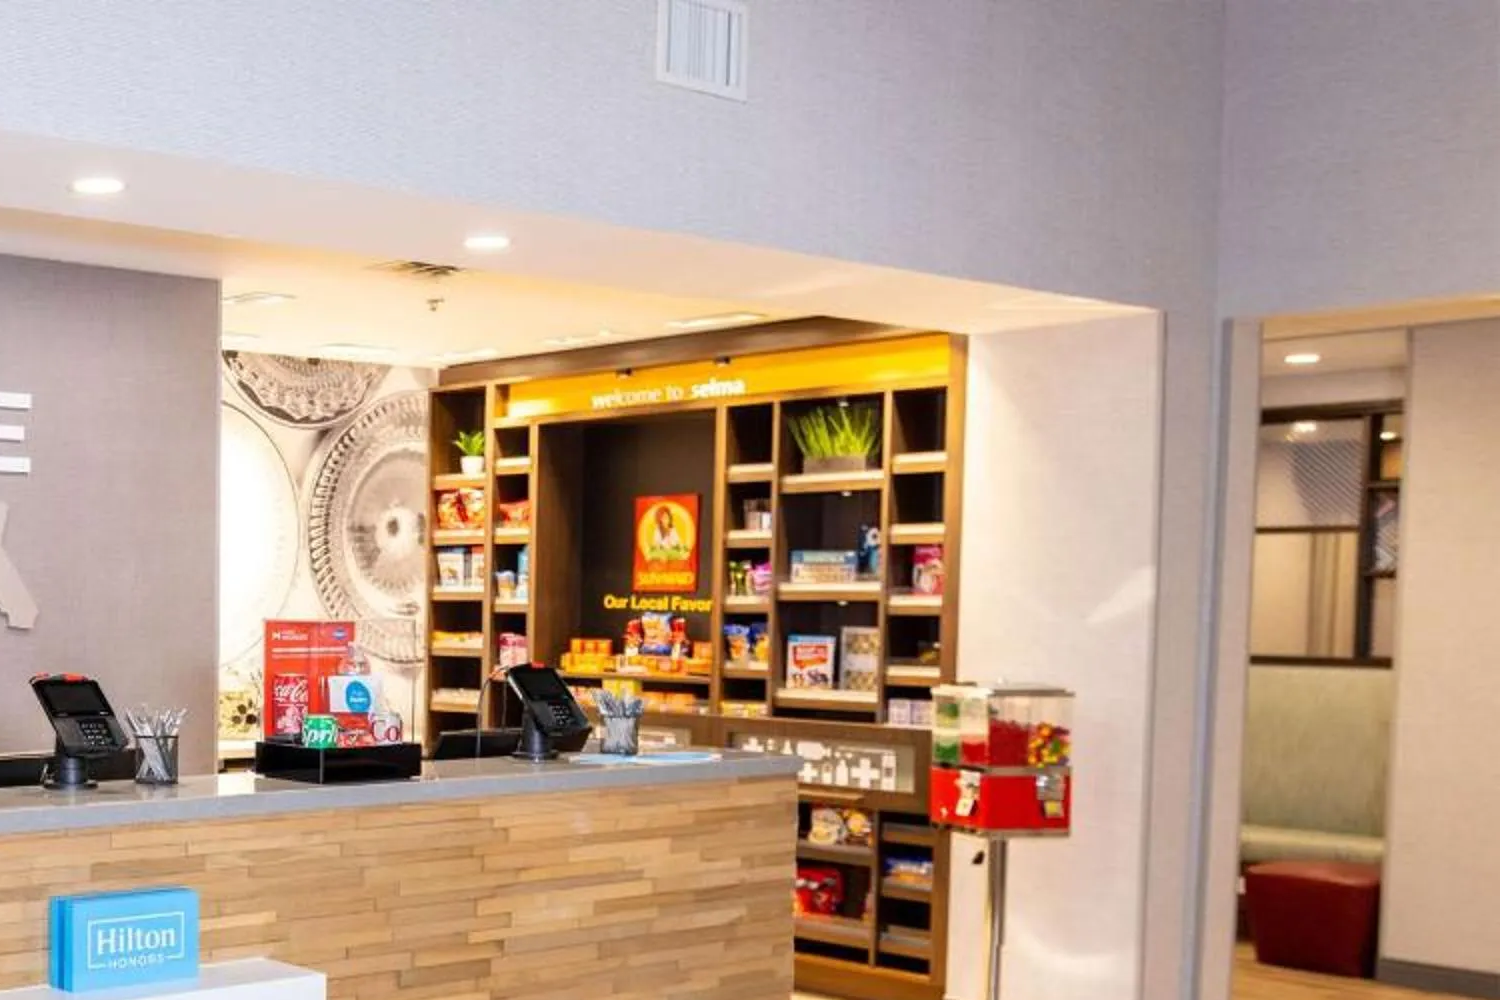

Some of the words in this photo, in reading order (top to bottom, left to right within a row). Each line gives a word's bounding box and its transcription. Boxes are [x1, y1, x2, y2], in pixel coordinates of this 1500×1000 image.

[592, 388, 662, 409] welcome
[665, 384, 684, 402] to
[692, 377, 746, 398] selma
[603, 594, 628, 609] Our
[631, 595, 669, 610] Local
[672, 596, 712, 611] Favor
[97, 926, 176, 955] Hilton
[108, 953, 165, 969] HONORS
